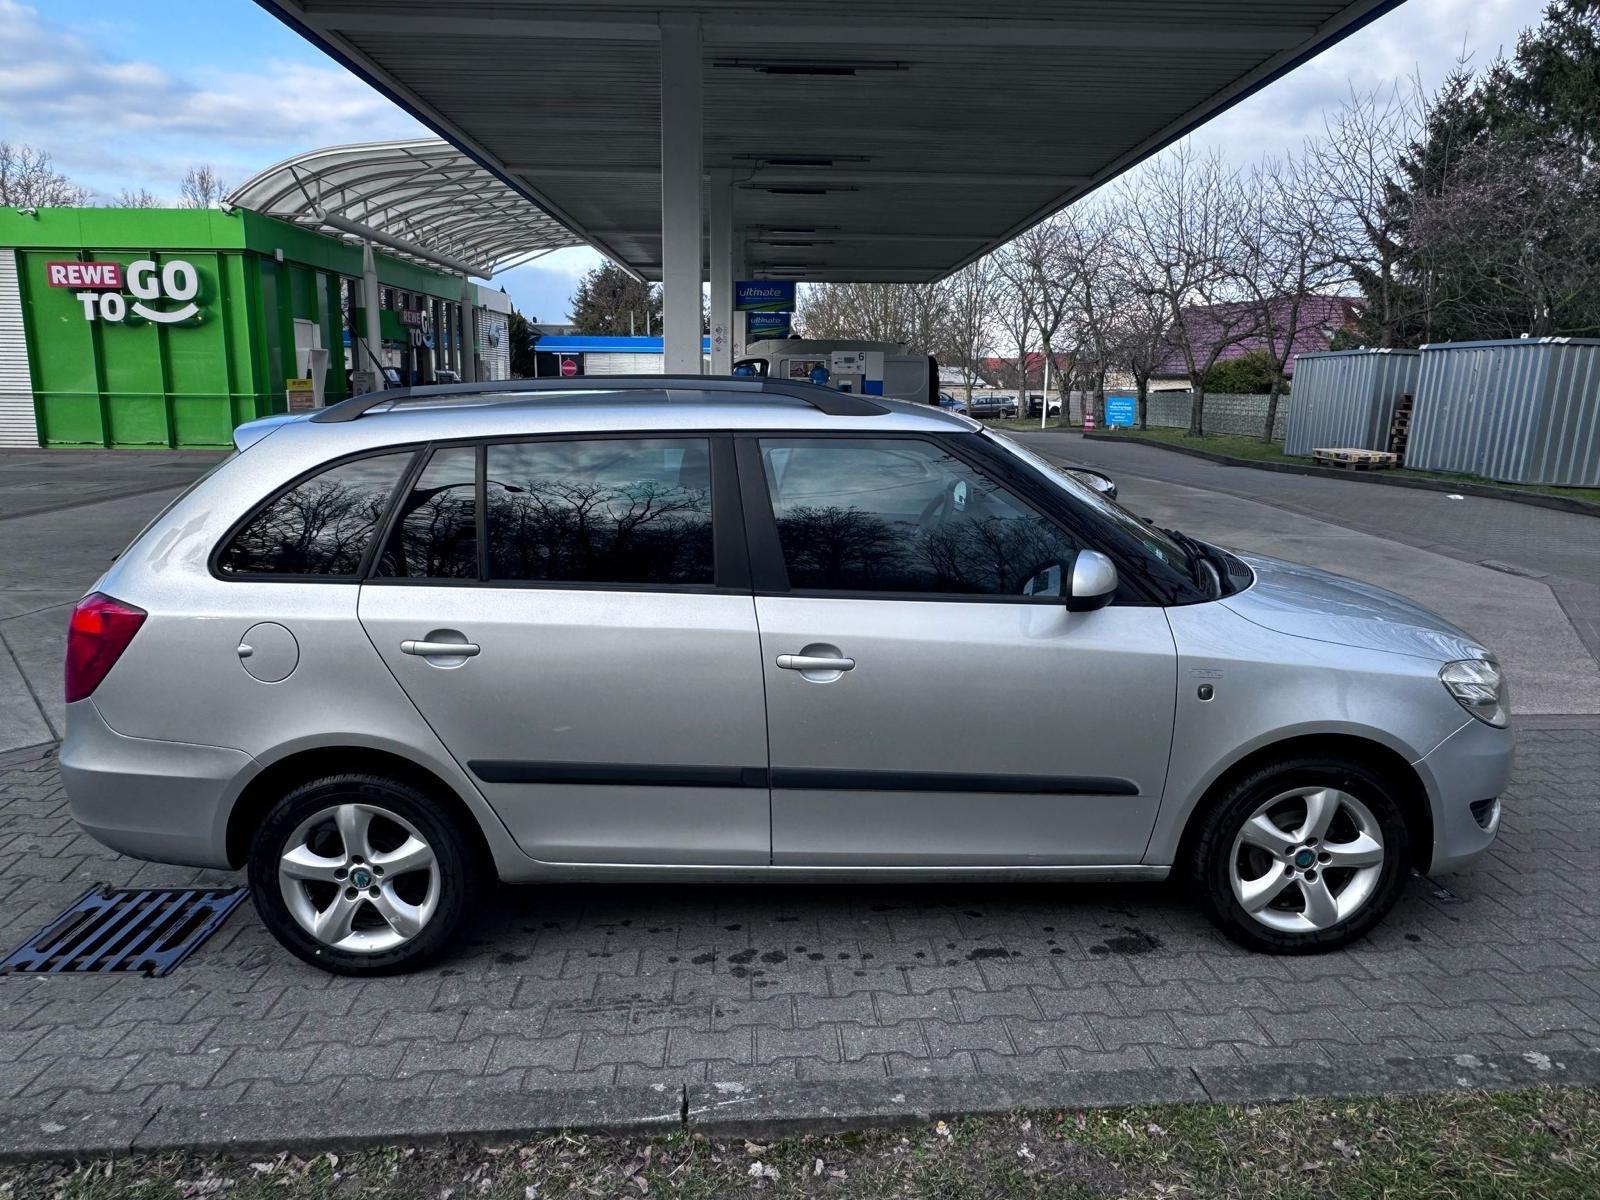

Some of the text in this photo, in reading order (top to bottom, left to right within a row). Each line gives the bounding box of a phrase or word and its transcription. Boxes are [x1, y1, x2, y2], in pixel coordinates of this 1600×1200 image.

[51, 259, 198, 301] REWE GO
[739, 287, 782, 297] ultimate
[76, 292, 126, 321] TO
[403, 310, 421, 324] REWE
[858, 352, 865, 361] 6
